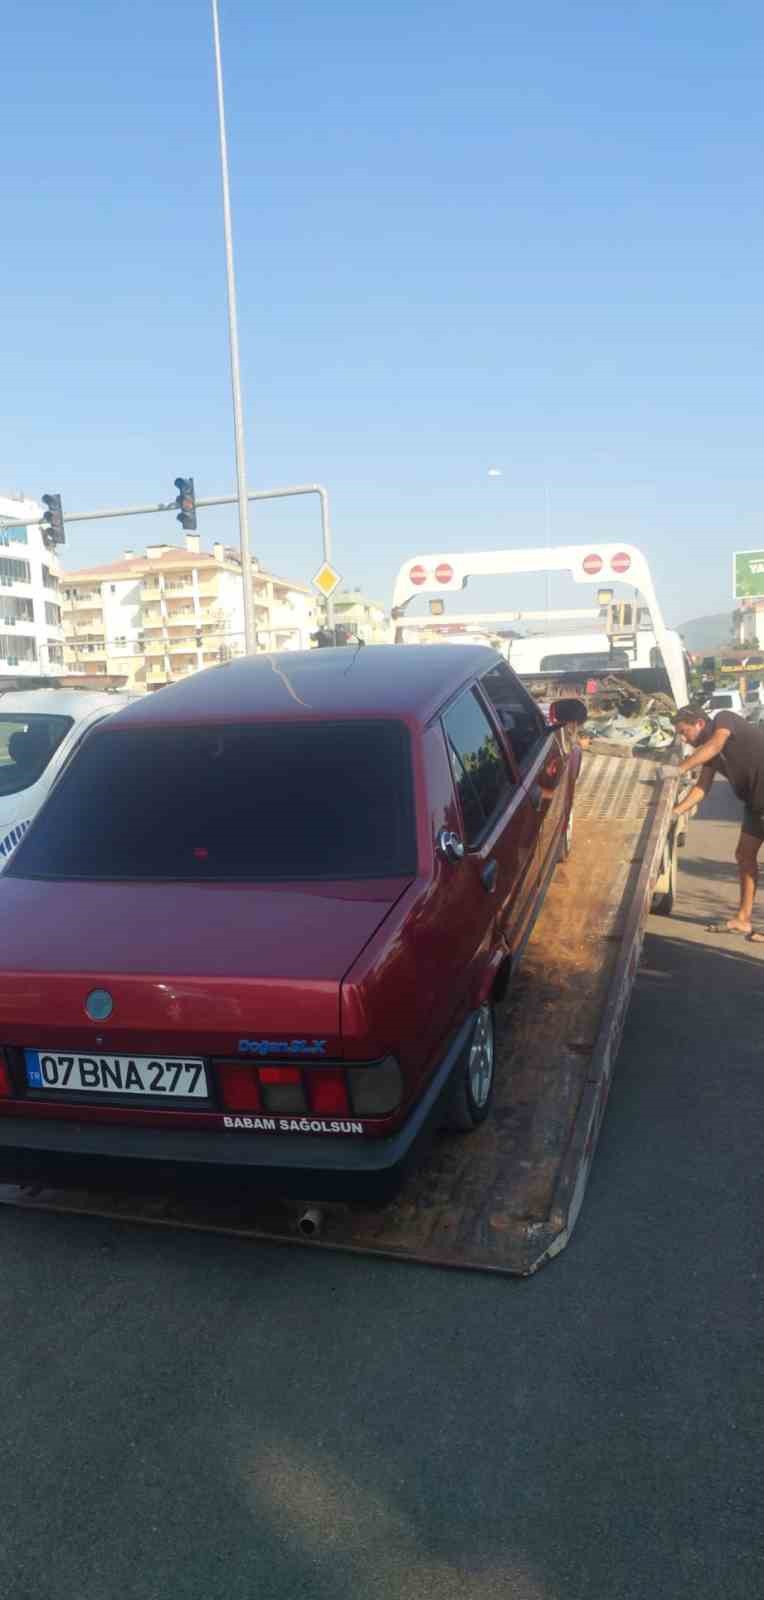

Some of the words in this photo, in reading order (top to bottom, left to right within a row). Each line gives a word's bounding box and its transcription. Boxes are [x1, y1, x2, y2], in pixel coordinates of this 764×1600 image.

[41, 1056, 75, 1086] 07
[78, 1057, 145, 1091] BNA
[147, 1061, 203, 1094] 277
[223, 1117, 276, 1130] BABAM
[279, 1118, 364, 1133] SAĞOLSUN
